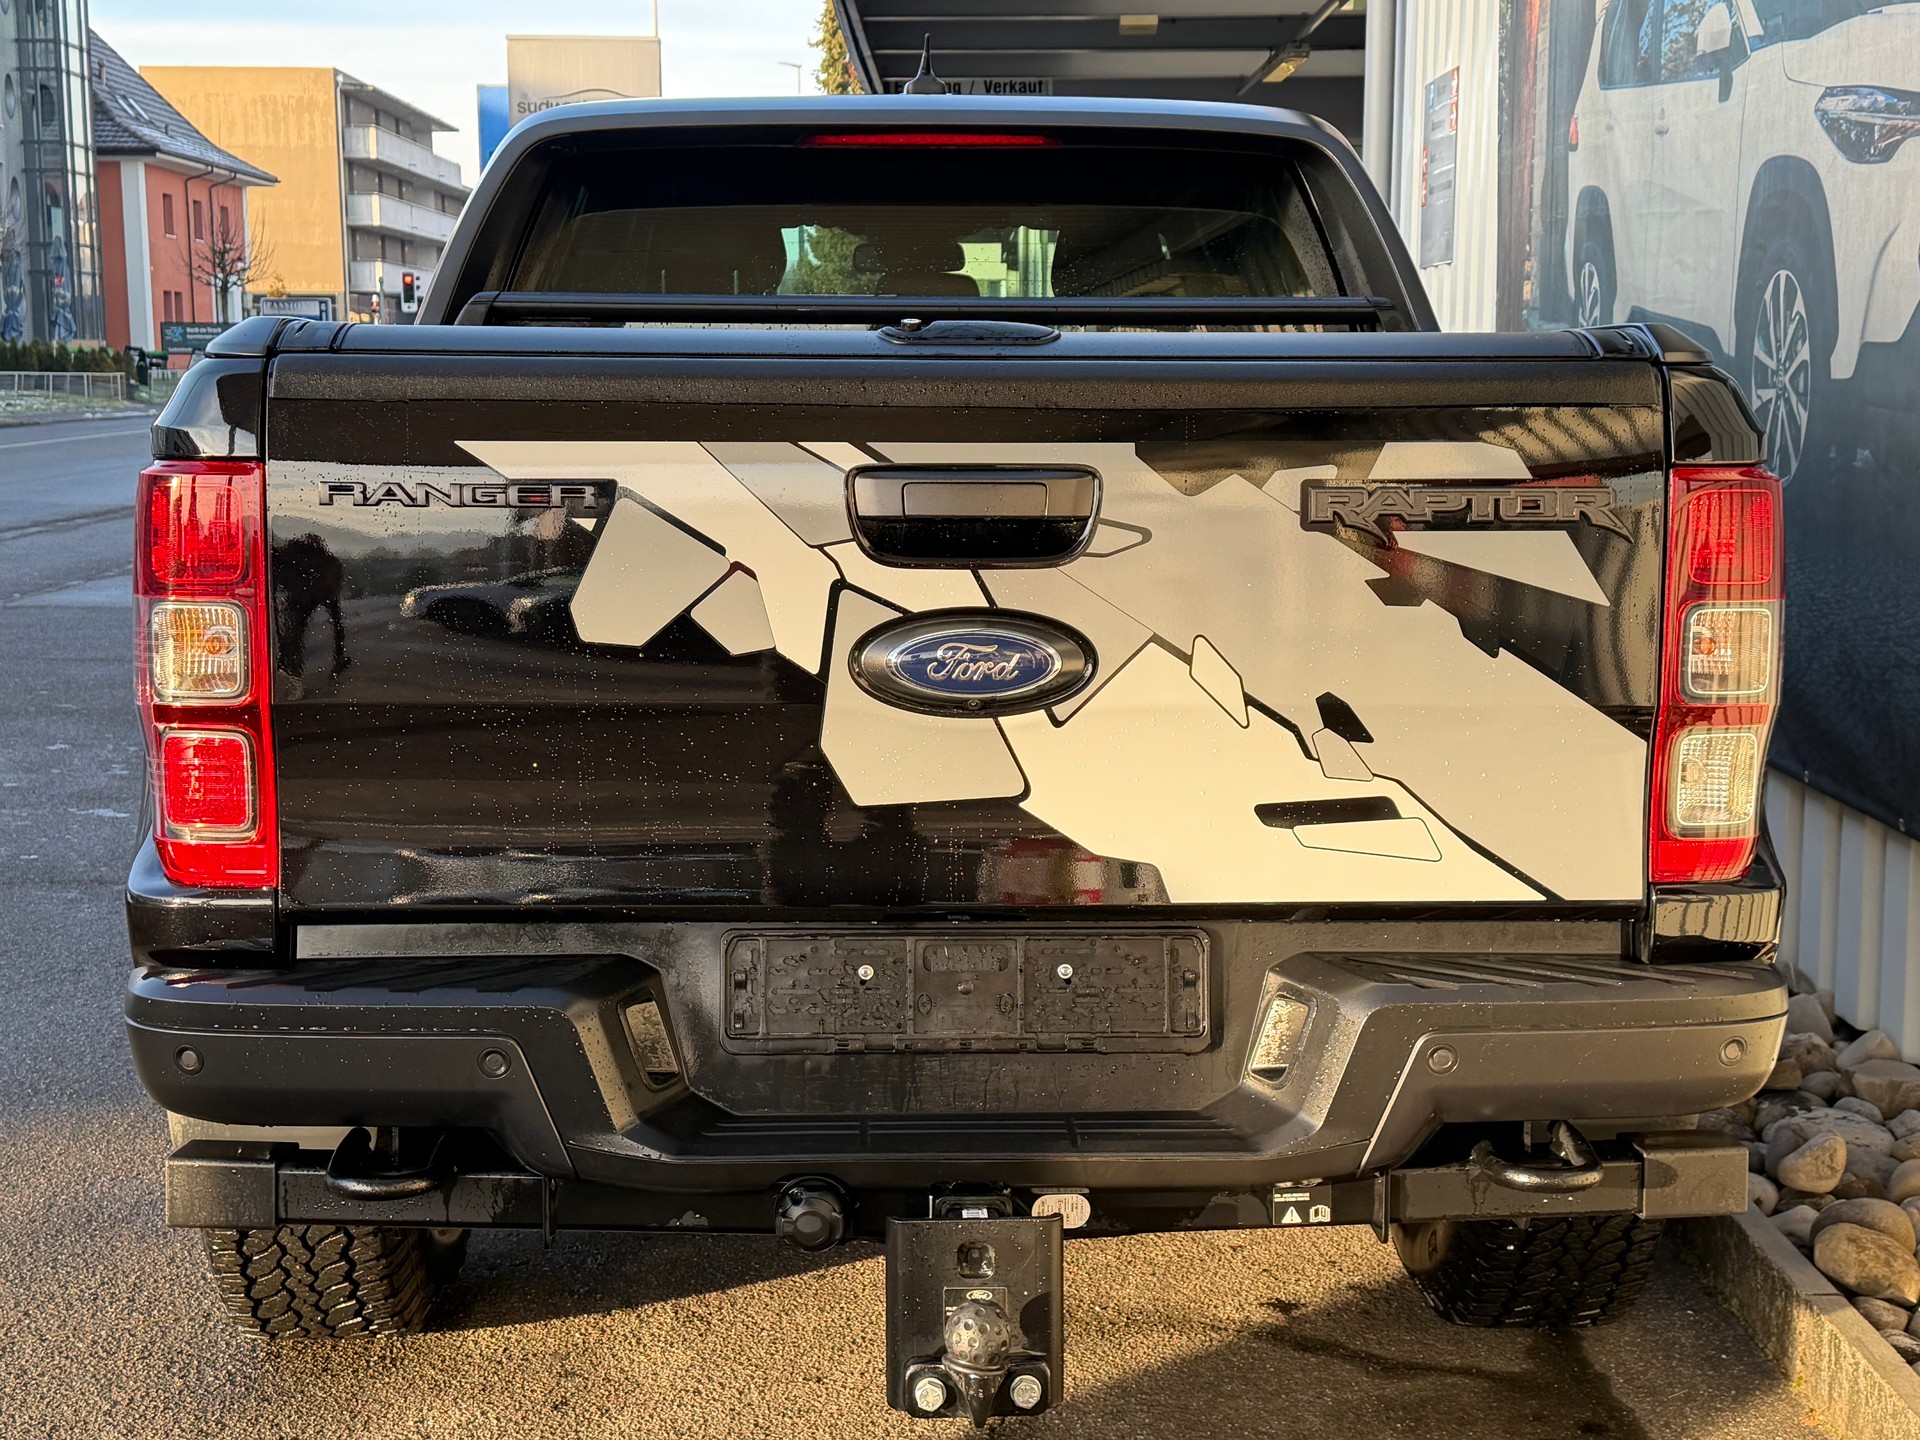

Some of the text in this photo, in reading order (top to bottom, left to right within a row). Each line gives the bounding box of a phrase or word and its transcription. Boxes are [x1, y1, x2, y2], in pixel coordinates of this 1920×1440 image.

[984, 80, 1043, 94] Verkauf
[318, 480, 599, 509] RANGER
[1307, 485, 1635, 546] RAPTOR
[926, 642, 1021, 682] Ford
